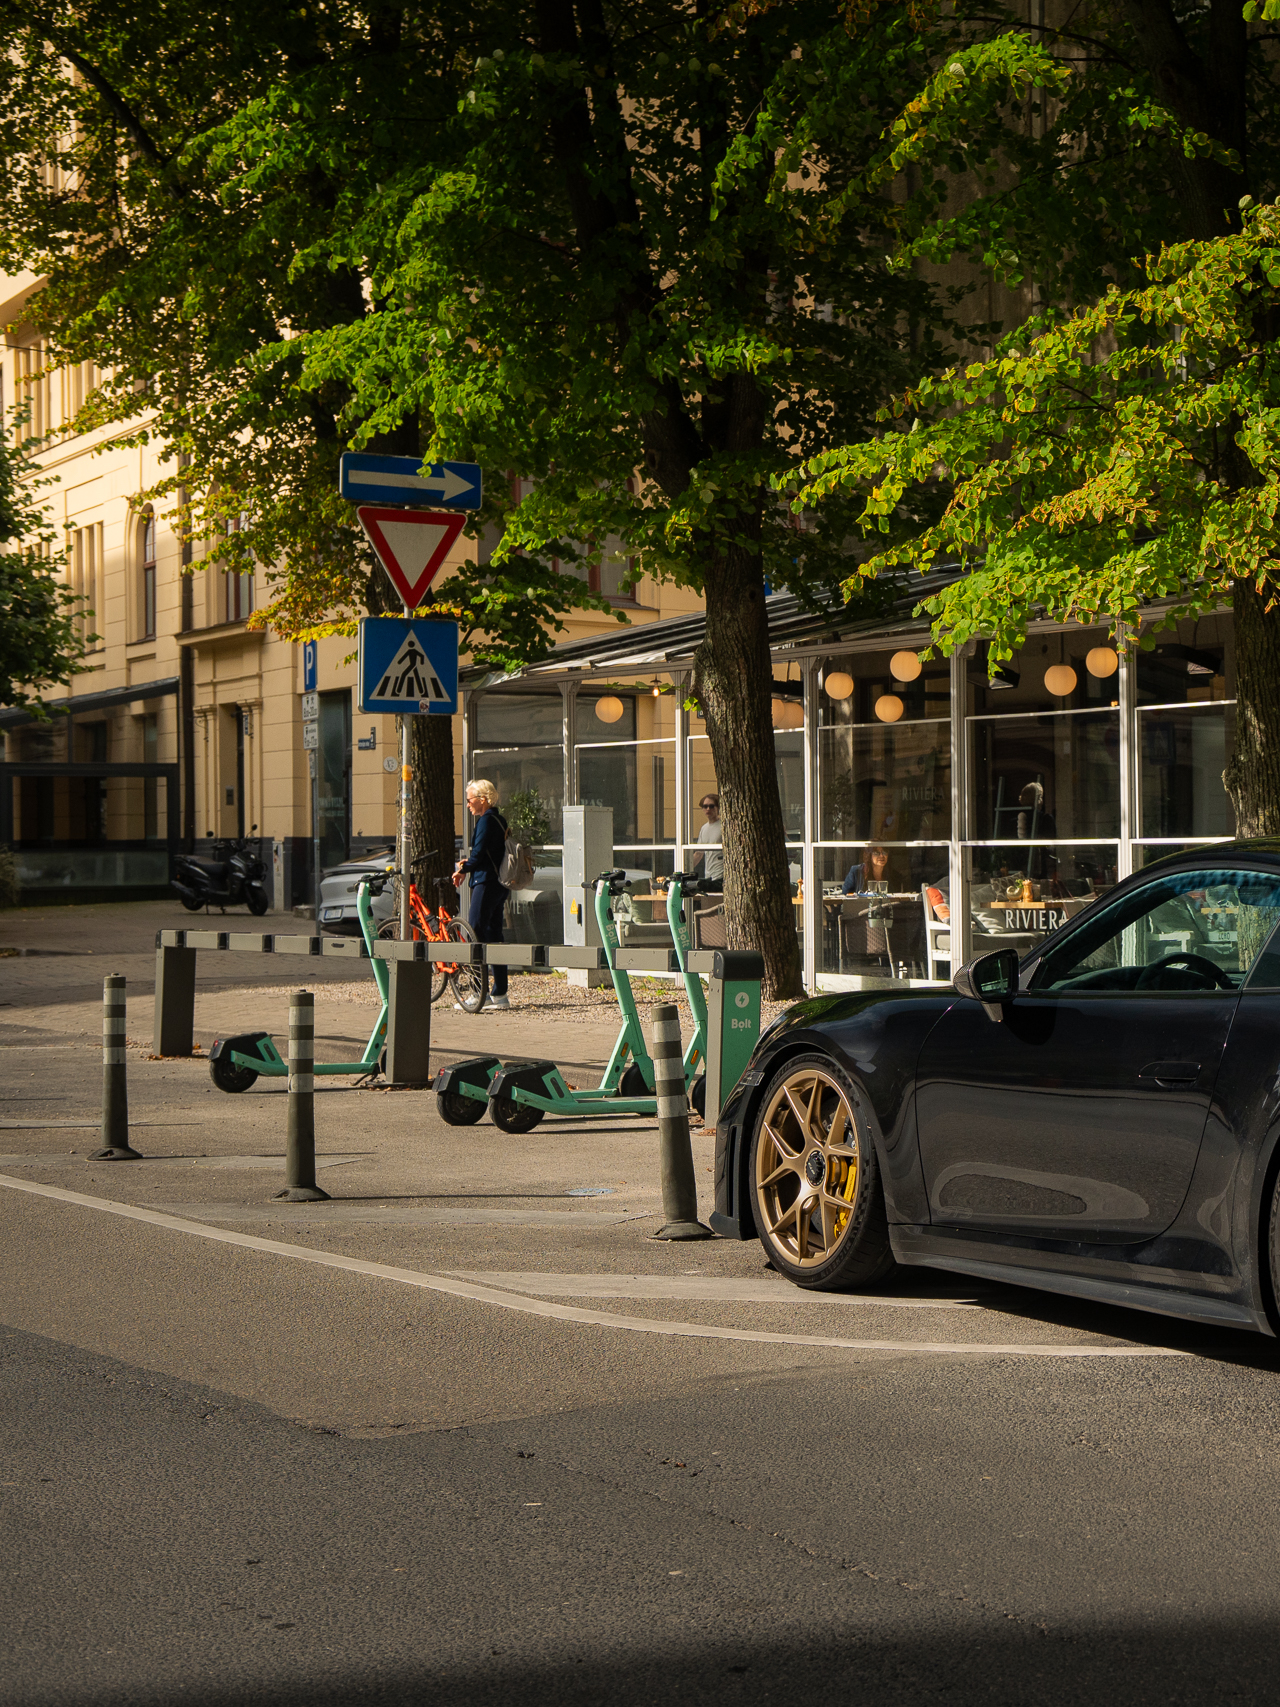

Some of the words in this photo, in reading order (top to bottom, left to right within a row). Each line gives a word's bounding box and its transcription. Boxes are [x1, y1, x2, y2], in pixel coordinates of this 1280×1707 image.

[902, 786, 945, 800] RIVIERA
[605, 924, 618, 945] Bolt
[678, 927, 691, 948] Bolt
[731, 1018, 751, 1031] Bolt
